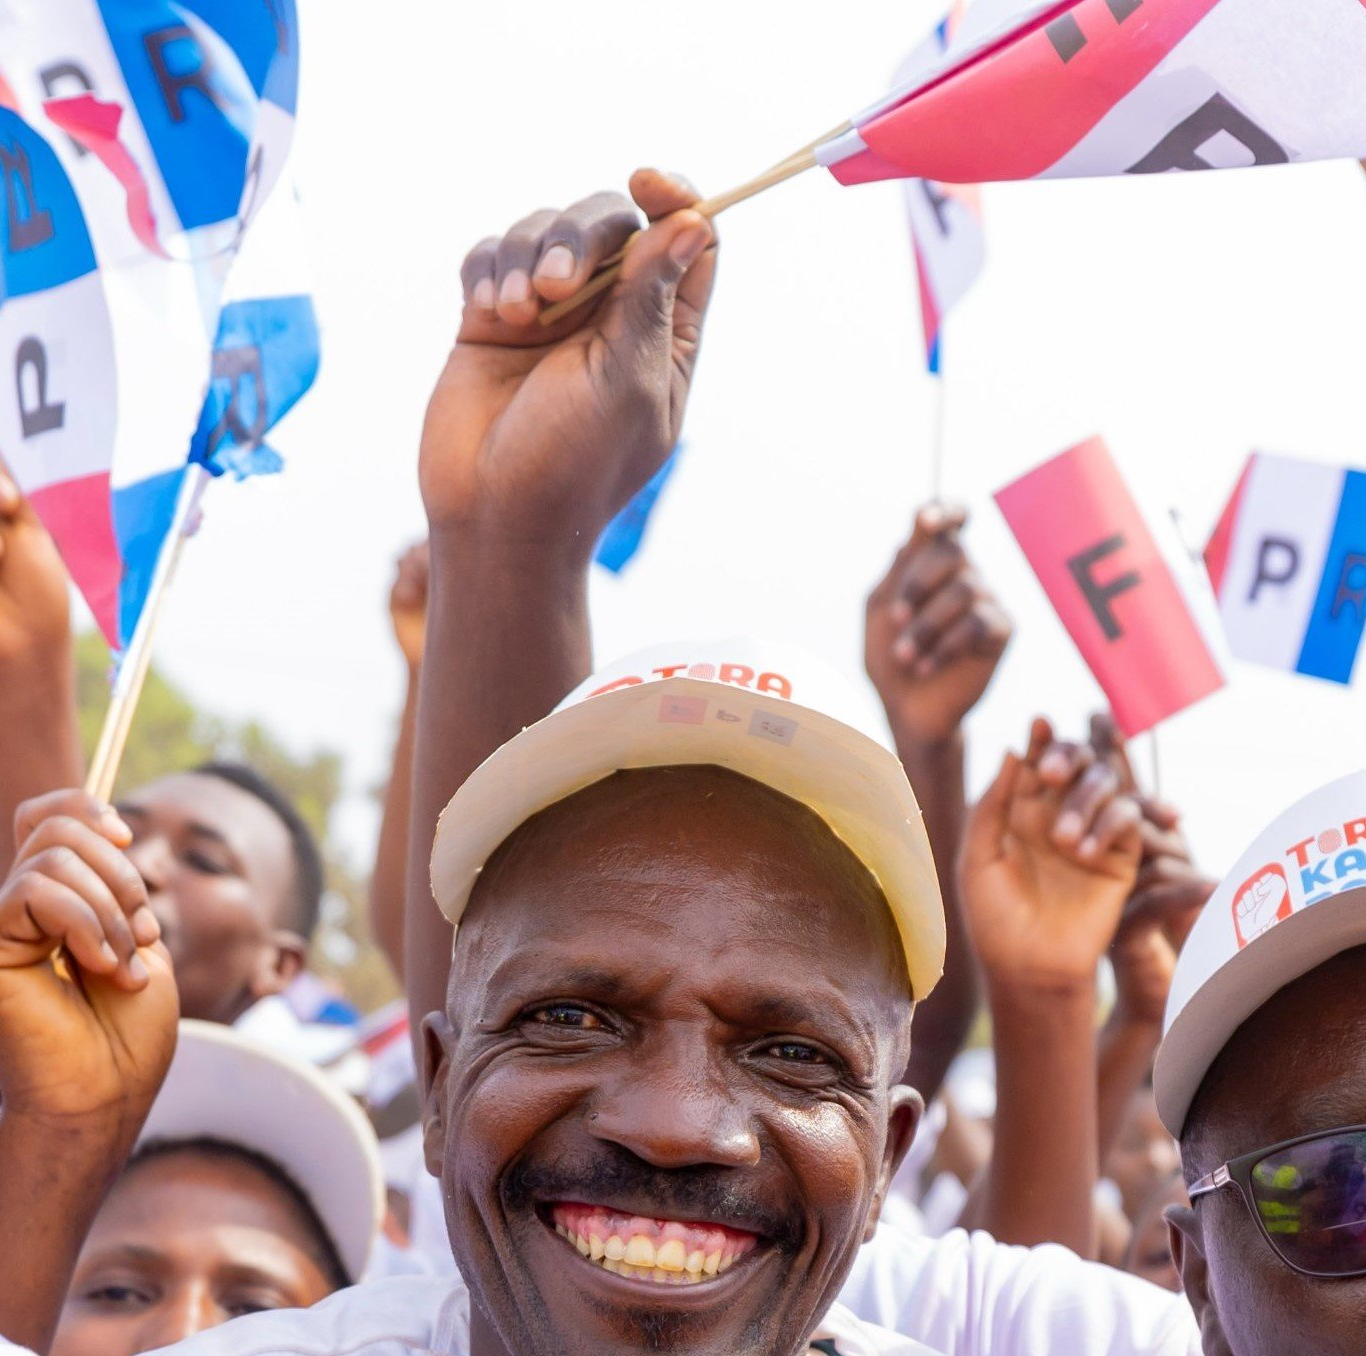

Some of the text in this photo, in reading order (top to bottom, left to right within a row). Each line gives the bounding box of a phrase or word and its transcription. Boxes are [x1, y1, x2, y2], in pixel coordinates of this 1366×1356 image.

[143, 24, 229, 122] R
[13, 334, 66, 440] P
[1066, 533, 1143, 643] F
[1249, 539, 1299, 603] P
